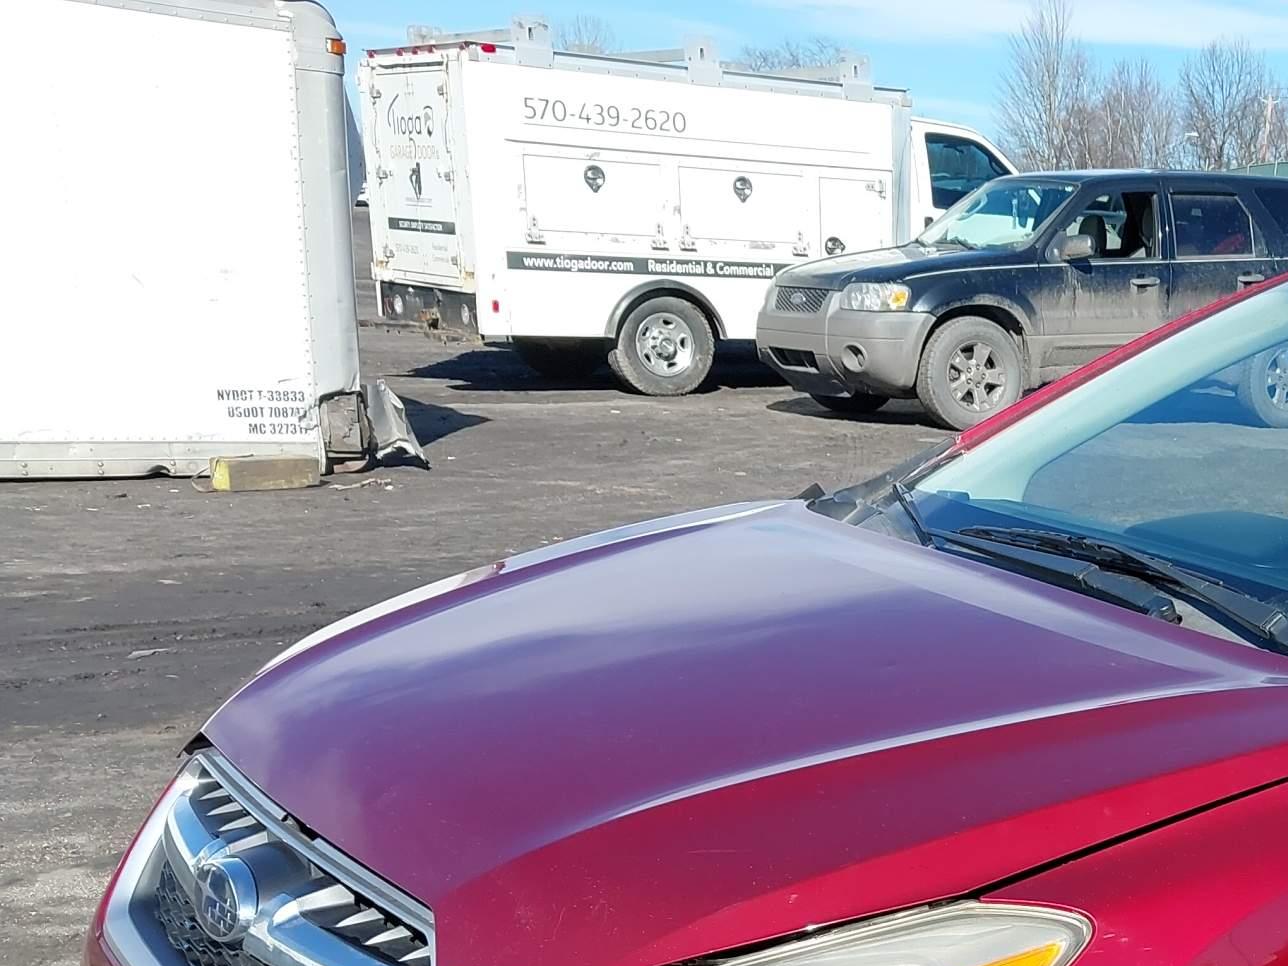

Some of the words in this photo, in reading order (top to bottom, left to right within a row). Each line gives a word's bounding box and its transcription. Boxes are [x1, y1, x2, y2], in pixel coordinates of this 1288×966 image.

[524, 97, 686, 133] 570-439-2620
[523, 256, 634, 272] www.tiogadoor.com
[648, 259, 705, 275] Residential
[706, 262, 715, 274] &
[716, 262, 774, 277] Commercial
[257, 390, 305, 402] T-33833
[228, 406, 265, 418] USDOT
[248, 423, 266, 434] MC
